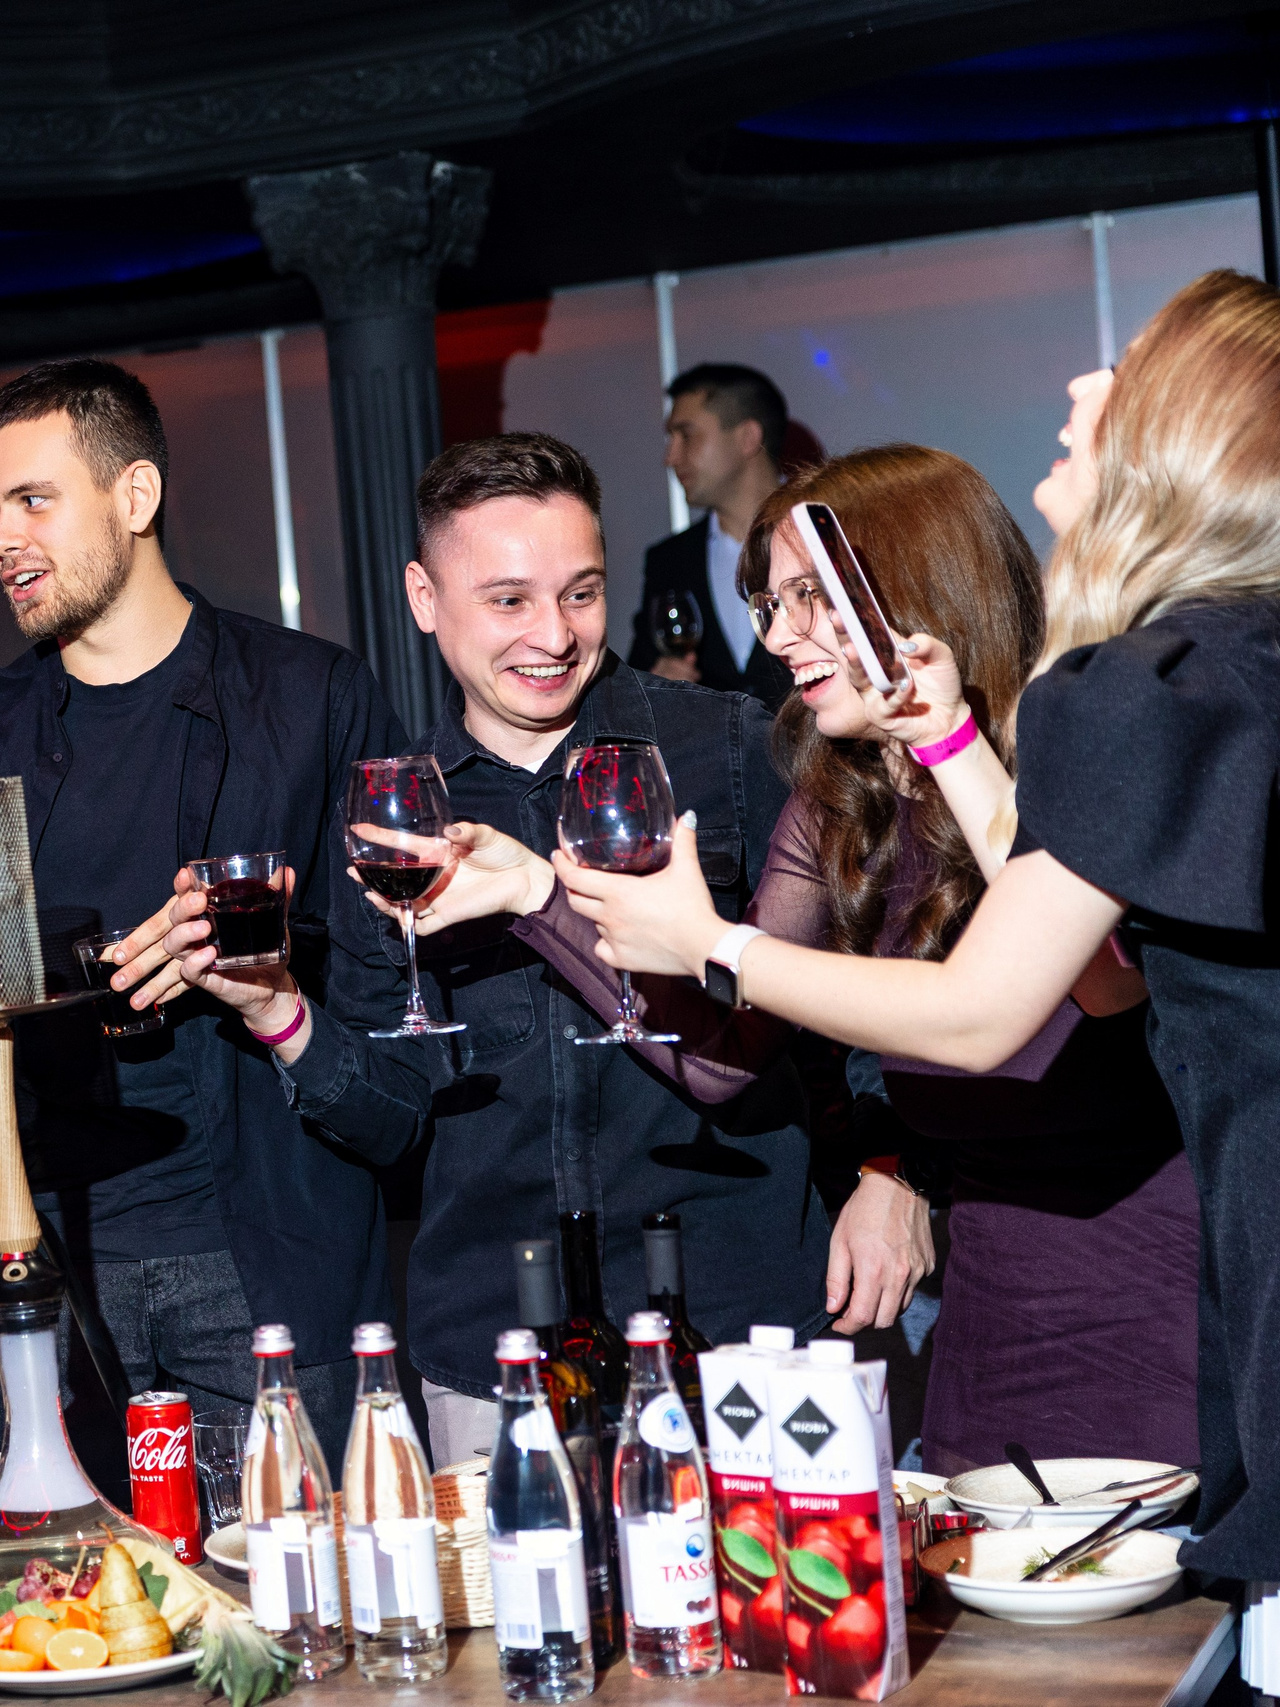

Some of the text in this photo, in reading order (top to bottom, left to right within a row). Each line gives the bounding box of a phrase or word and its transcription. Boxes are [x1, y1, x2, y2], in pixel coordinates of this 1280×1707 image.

[722, 1404, 757, 1419] RIOBA
[789, 1421, 830, 1435] RIOBA
[780, 1468, 851, 1483] НЕКТАР
[722, 1476, 766, 1493] ВИШНЯ
[789, 1496, 840, 1512] ВИШНЯ
